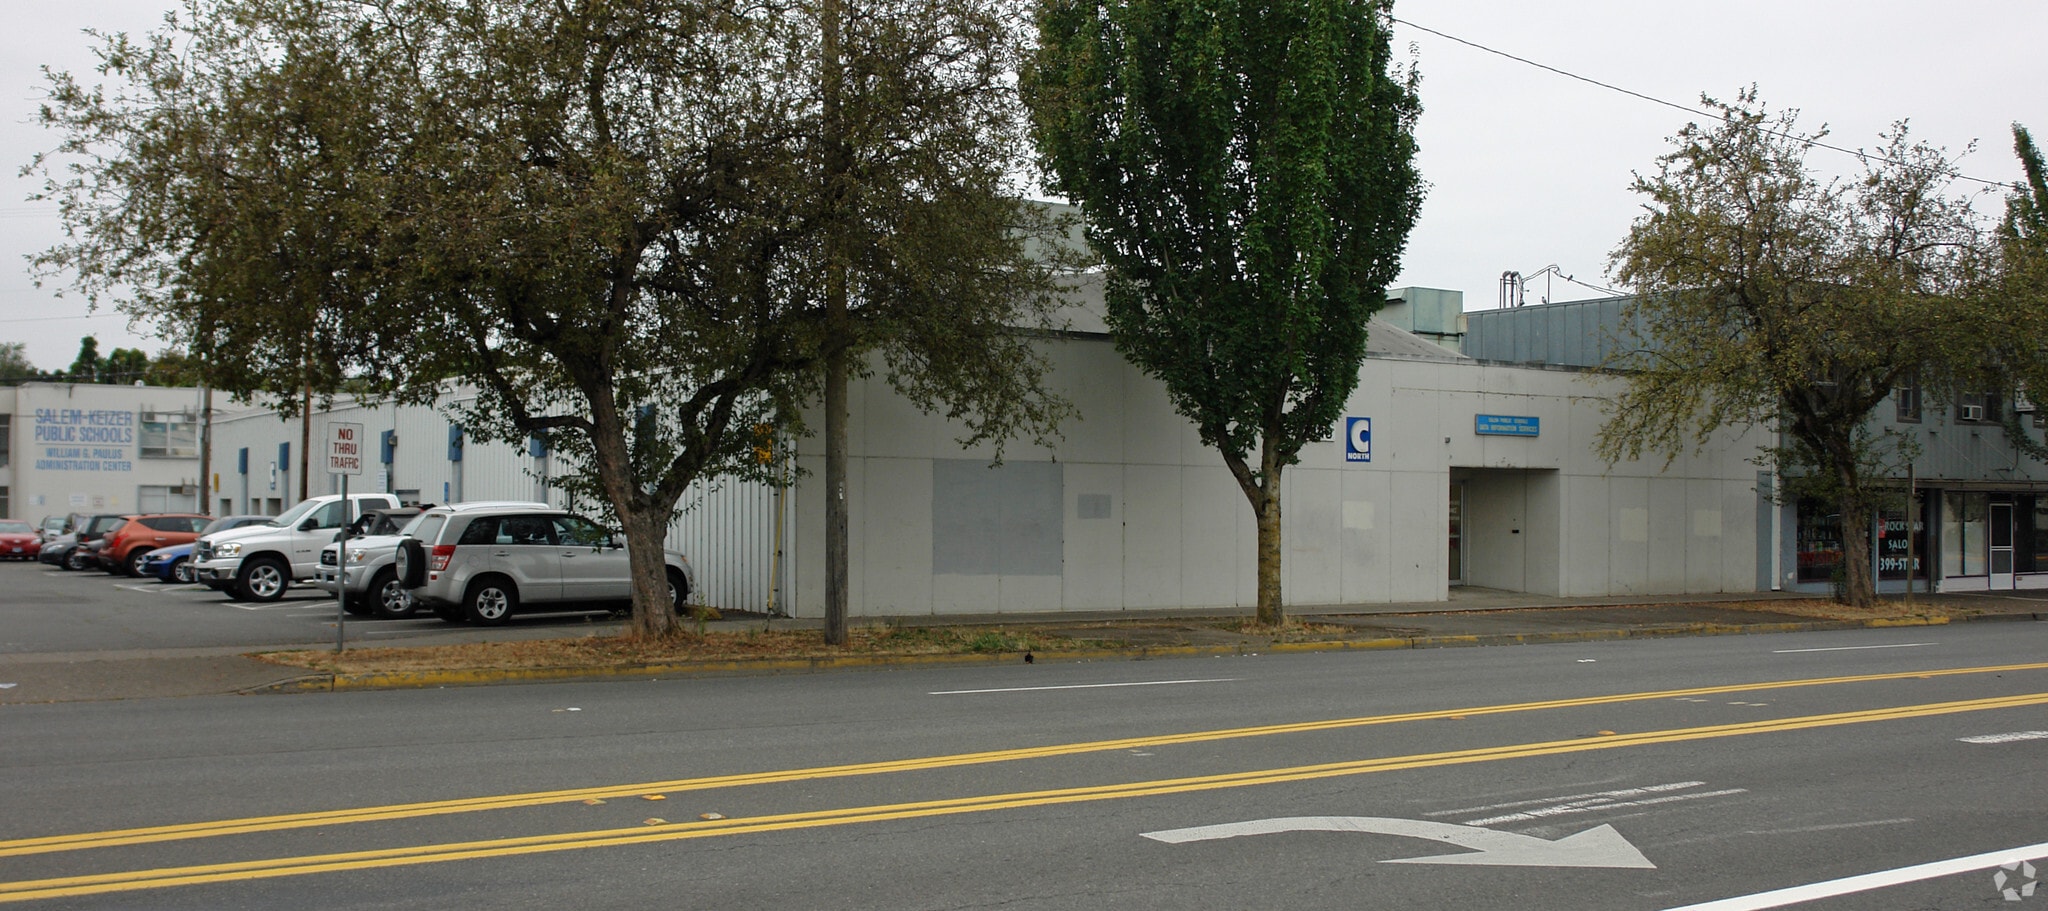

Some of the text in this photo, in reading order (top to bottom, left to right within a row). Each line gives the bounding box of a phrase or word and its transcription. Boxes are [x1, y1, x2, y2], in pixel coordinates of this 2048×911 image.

[35, 408, 133, 426] SALEM-KEIZER
[35, 425, 132, 443] PUBLIC SCHOOLS
[338, 428, 353, 440] NO
[1350, 419, 1369, 453] C
[45, 447, 80, 458] WILLIAM
[93, 448, 122, 459] PAULUS
[333, 442, 357, 455] THRU
[1347, 452, 1370, 460] NORTH
[35, 459, 132, 471] ADMINISTRATION CENTER
[330, 456, 359, 469] TRAFFIC
[1884, 521, 1924, 531] ROCK SAR
[1888, 539, 1908, 549] SALO
[1880, 557, 1920, 571] 399-STR
